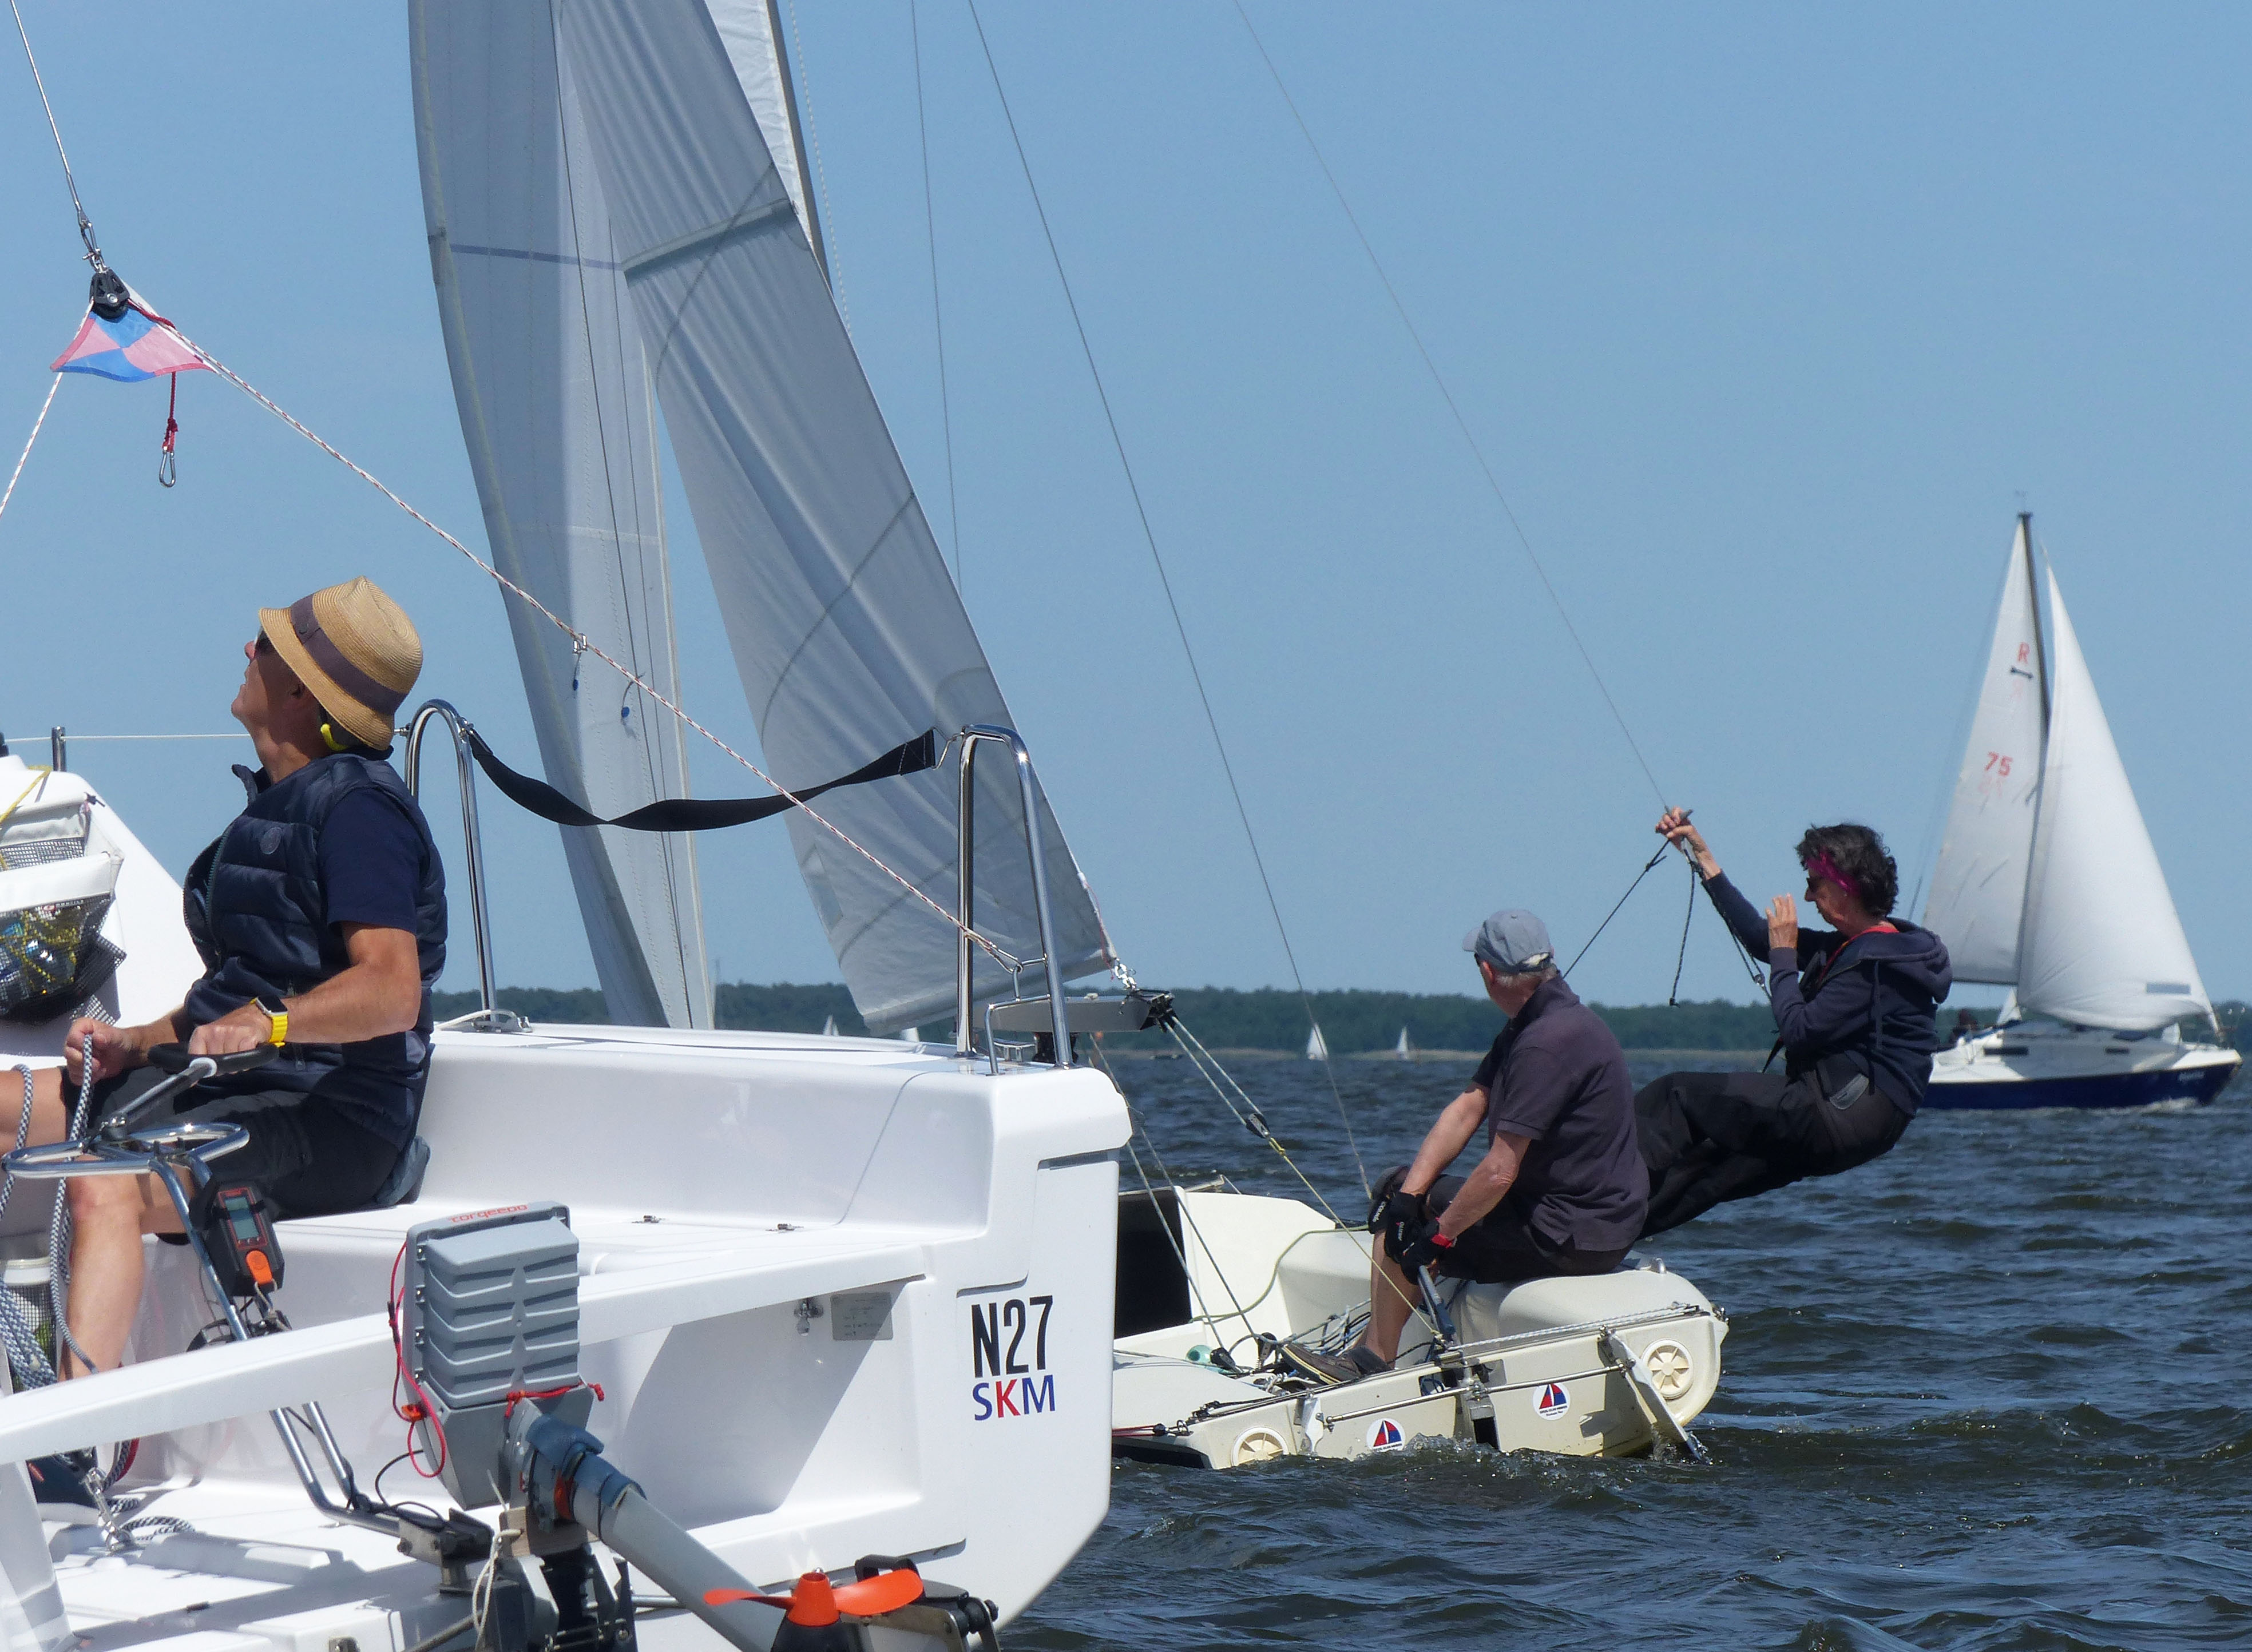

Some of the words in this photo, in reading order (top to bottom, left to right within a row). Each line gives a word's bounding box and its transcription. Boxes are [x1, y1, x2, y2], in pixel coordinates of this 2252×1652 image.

[2017, 642, 2030, 664] R
[1984, 751, 2013, 776] 75
[971, 1294, 1053, 1378] N27
[972, 1374, 1056, 1421] SKM
